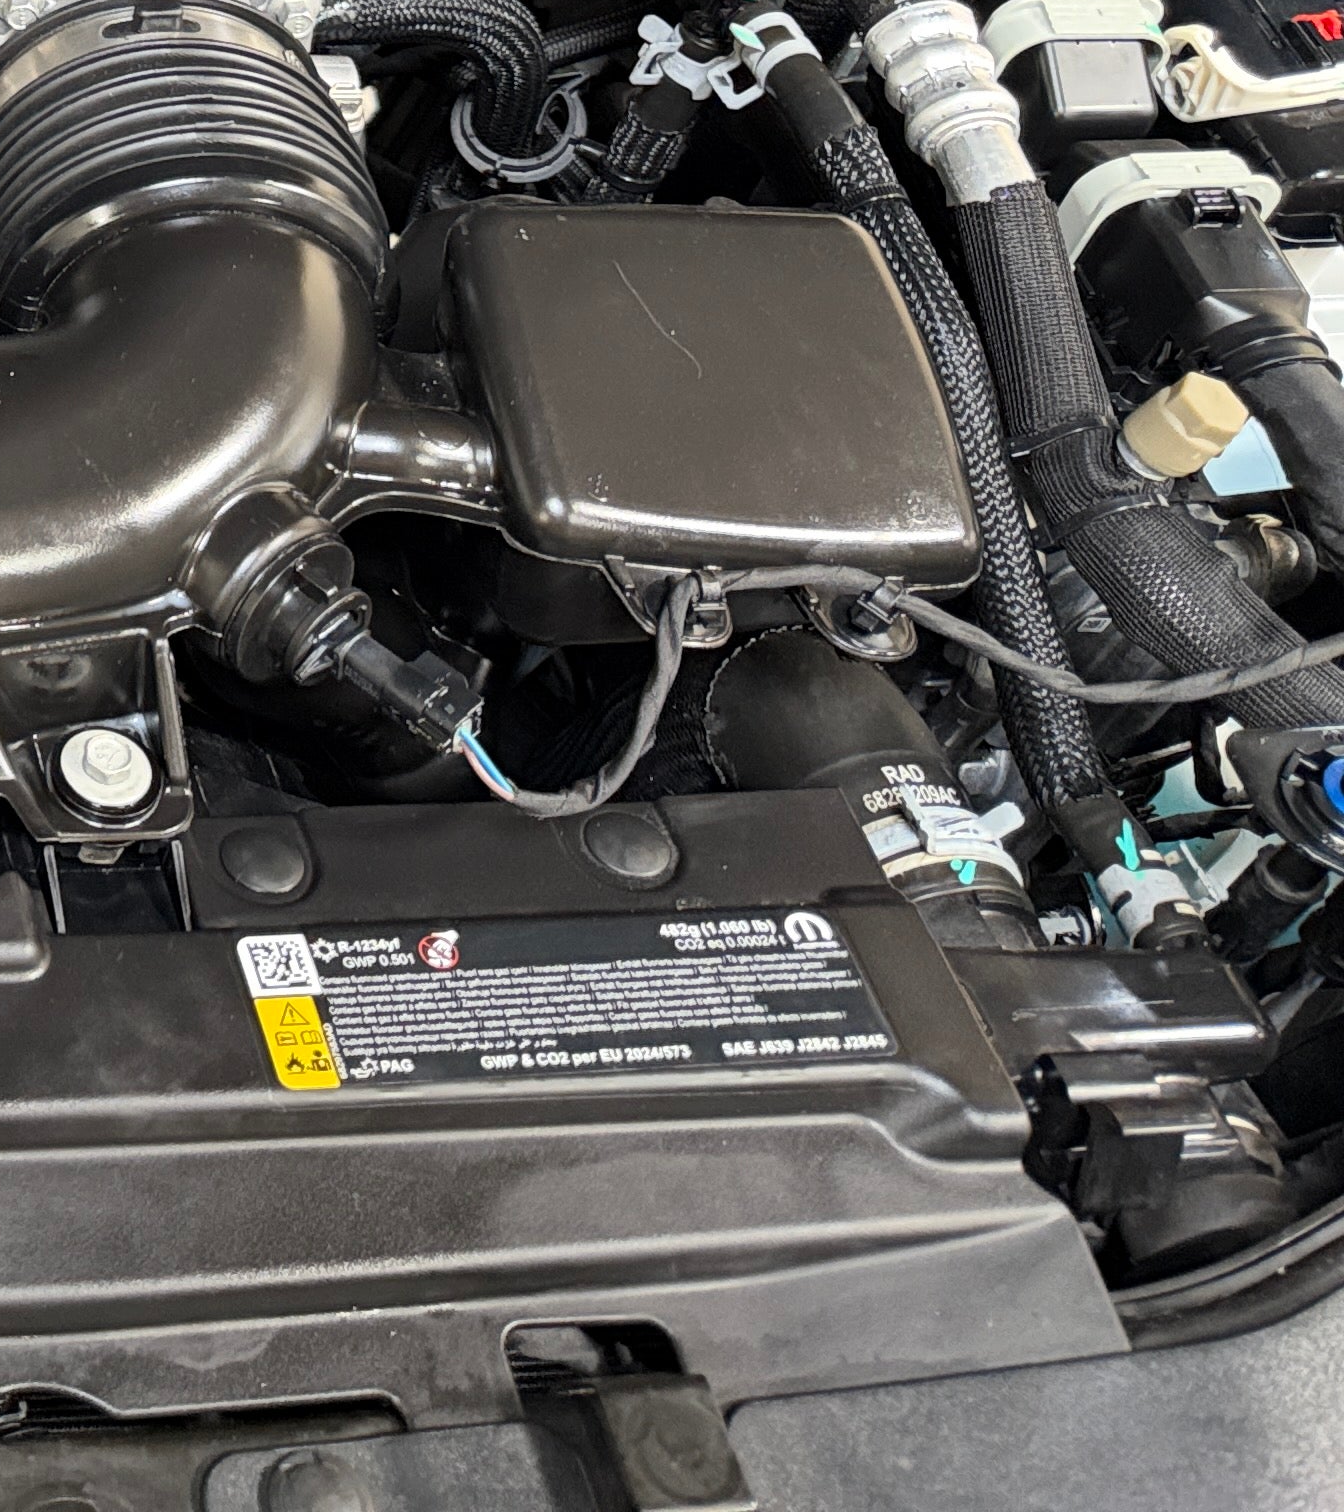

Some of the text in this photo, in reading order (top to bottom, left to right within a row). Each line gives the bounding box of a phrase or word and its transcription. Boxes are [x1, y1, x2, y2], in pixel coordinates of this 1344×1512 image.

[880, 763, 926, 784] RAD
[751, 919, 777, 936] lb)
[674, 938, 706, 952] CO2
[706, 938, 727, 951] eq
[725, 934, 778, 949] 0.00024
[342, 952, 417, 970] GWP 0.501
[480, 1044, 693, 1070] GWP & CO2 per EU 2024/573
[721, 1041, 758, 1057] SAE
[757, 1039, 795, 1055] J639
[379, 1058, 415, 1074] PAG
